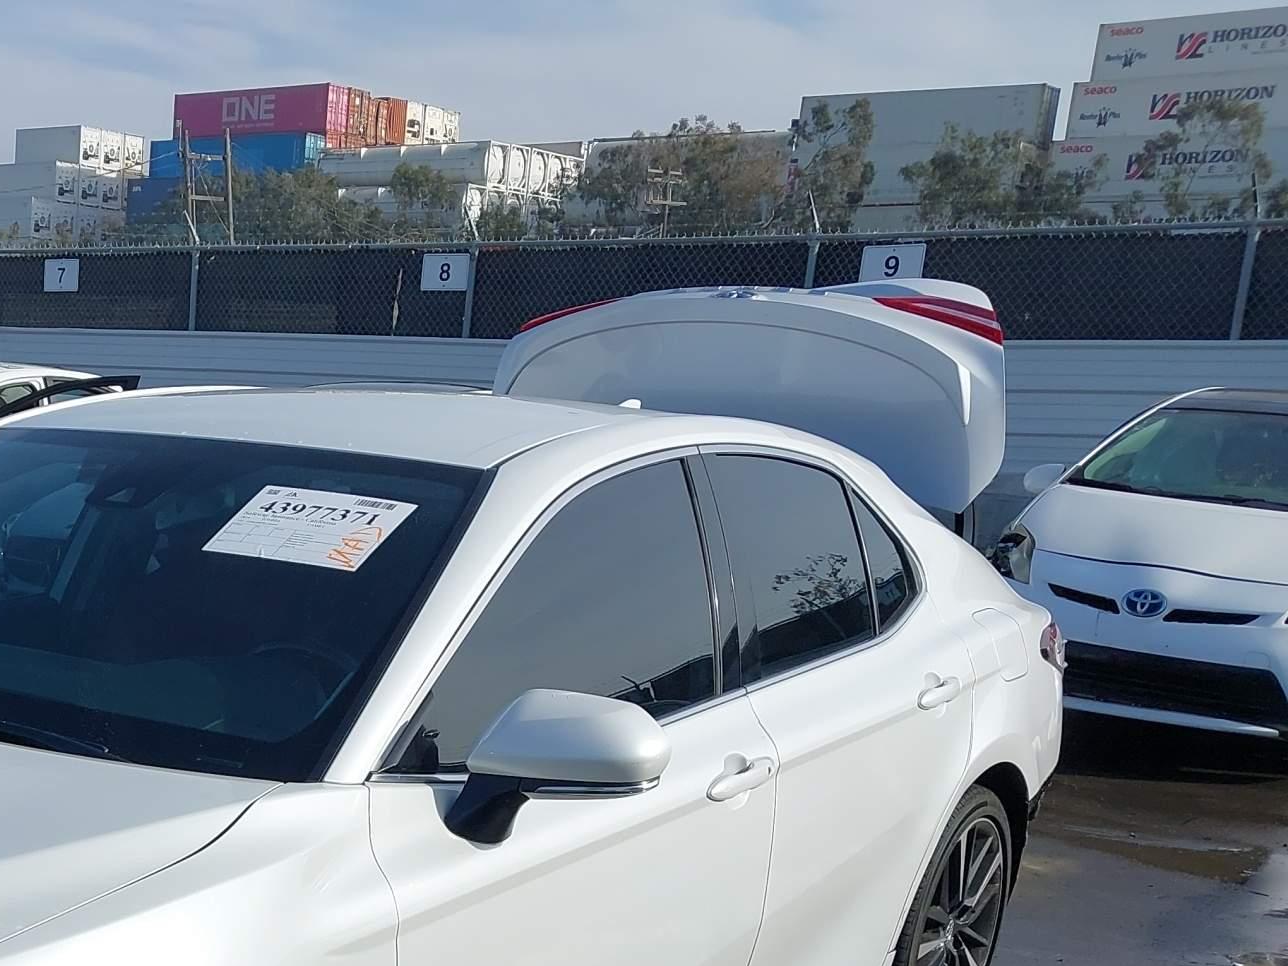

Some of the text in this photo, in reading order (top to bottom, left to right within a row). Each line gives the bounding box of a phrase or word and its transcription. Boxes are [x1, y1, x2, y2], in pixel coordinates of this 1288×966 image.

[1211, 24, 1288, 43] HORIZO
[1083, 86, 1117, 96] seaco
[1184, 84, 1277, 105] HORIZON
[222, 95, 276, 121] ONE
[1059, 144, 1093, 154] seaco
[1160, 148, 1251, 166] HORIZON
[57, 267, 66, 284] 7
[439, 262, 451, 282] 8
[883, 255, 900, 278] 9
[259, 500, 381, 526] 43977371
